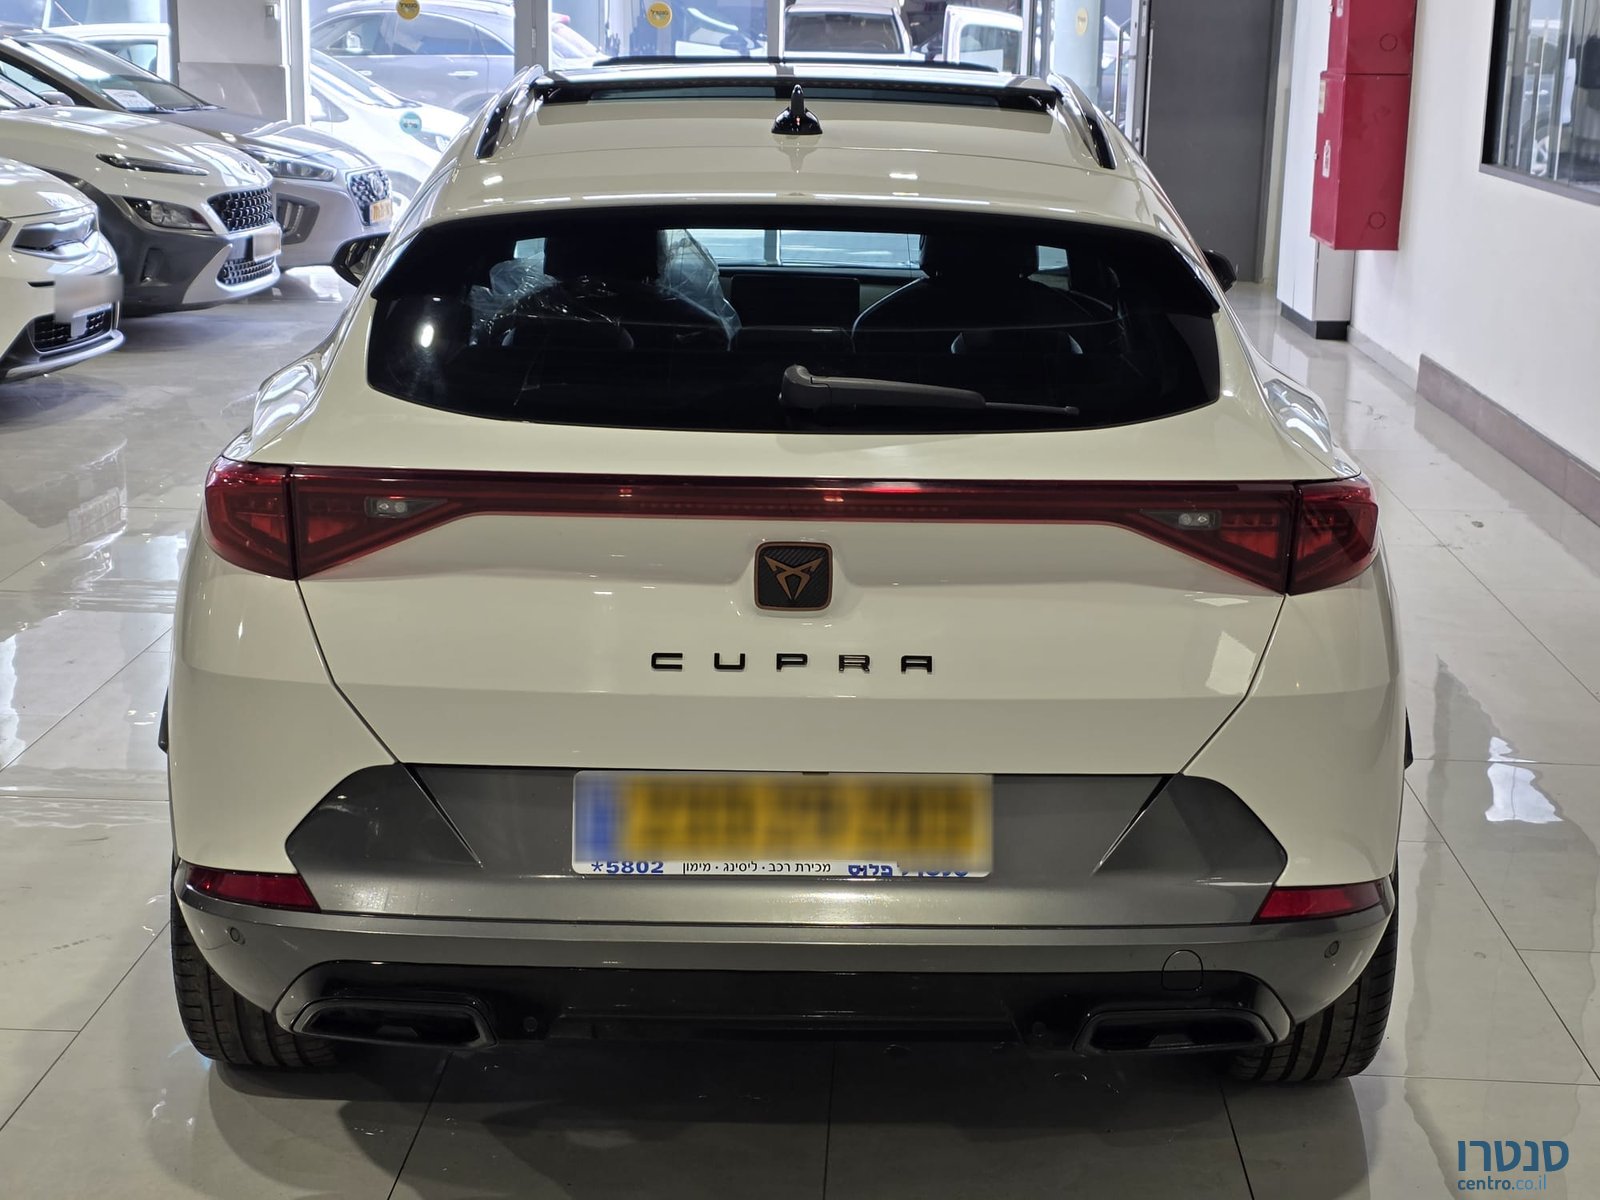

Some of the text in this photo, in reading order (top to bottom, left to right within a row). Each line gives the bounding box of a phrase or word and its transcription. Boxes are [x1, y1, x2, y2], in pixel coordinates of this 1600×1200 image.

[651, 652, 933, 672] CUPRA
[682, 861, 831, 874] מכירת רכב ליסינג מימון
[848, 864, 893, 877] פלוס
